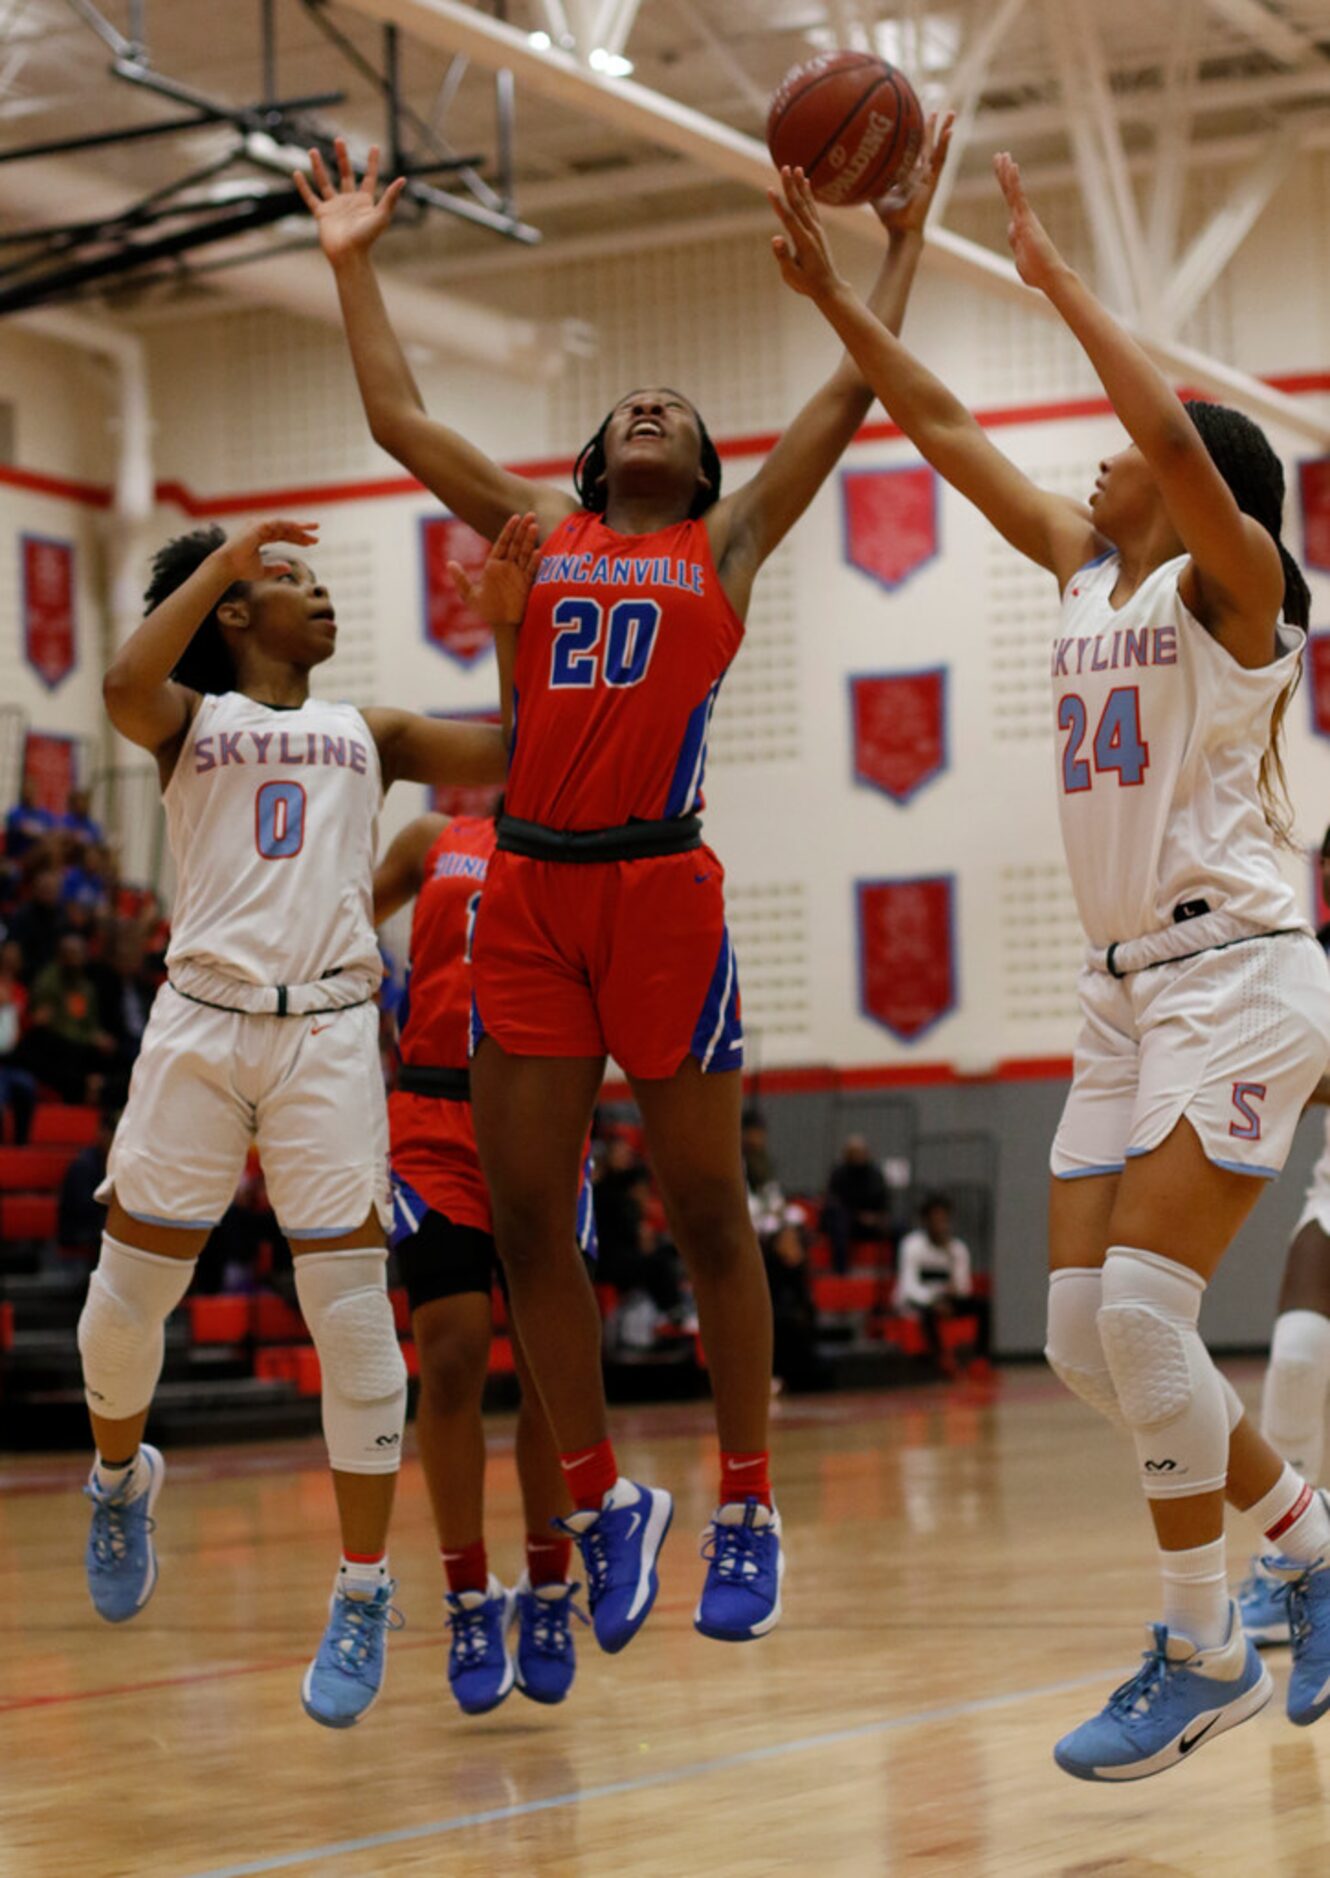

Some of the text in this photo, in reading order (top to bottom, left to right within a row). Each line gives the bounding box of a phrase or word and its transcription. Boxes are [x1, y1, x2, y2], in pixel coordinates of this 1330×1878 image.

[549, 597, 662, 690] 20
[1051, 626, 1177, 677] KYLINE
[195, 731, 367, 775] SKYLINE
[1057, 685, 1149, 794] 24
[255, 780, 307, 861] 0
[1229, 1082, 1267, 1140] S
